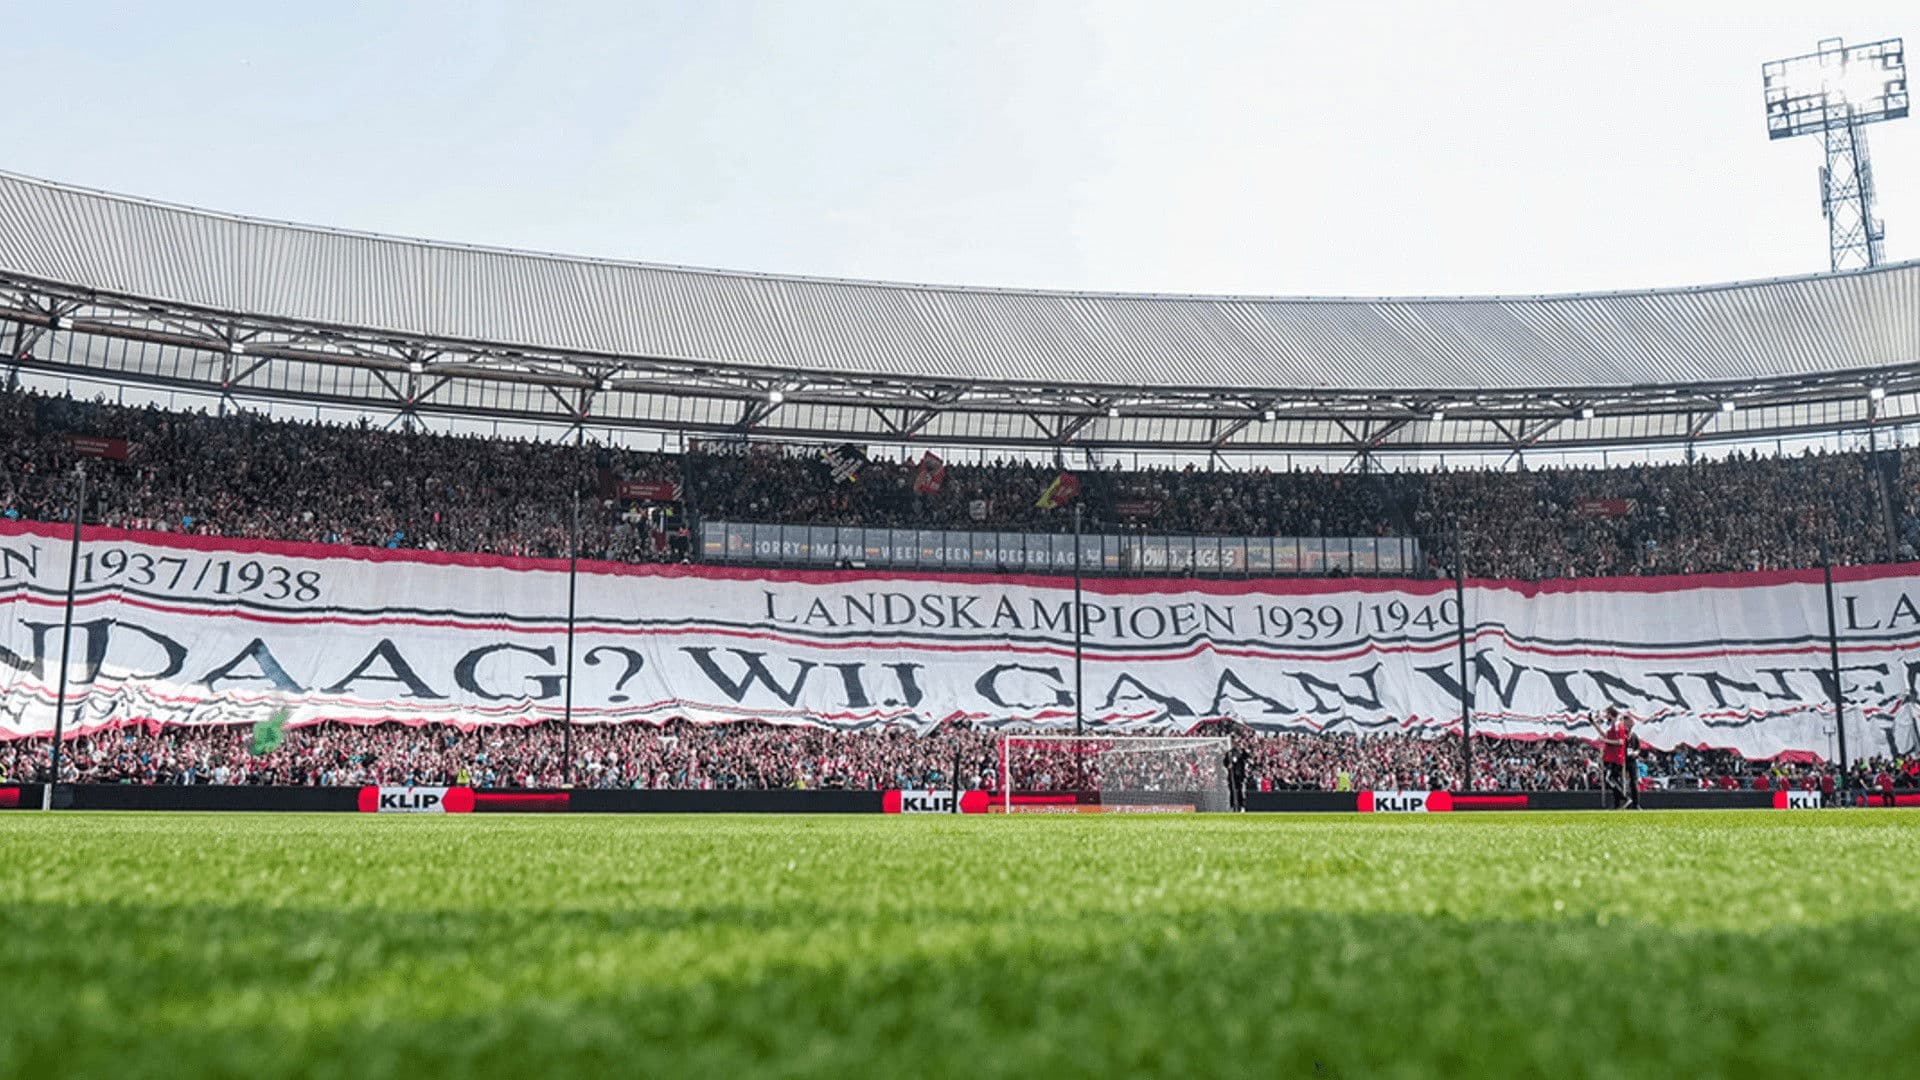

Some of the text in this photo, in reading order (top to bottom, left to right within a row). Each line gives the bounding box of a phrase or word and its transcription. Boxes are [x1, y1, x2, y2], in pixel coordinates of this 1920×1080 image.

[80, 548, 322, 601] 1937/1938
[763, 590, 1462, 640] LANDSKAMPIOEN 1939/1940
[1842, 592, 1920, 630] LA
[678, 646, 925, 708] WIJ
[974, 661, 1384, 716] GAAN
[381, 794, 439, 809] KLIP
[1375, 798, 1423, 811] KLIP
